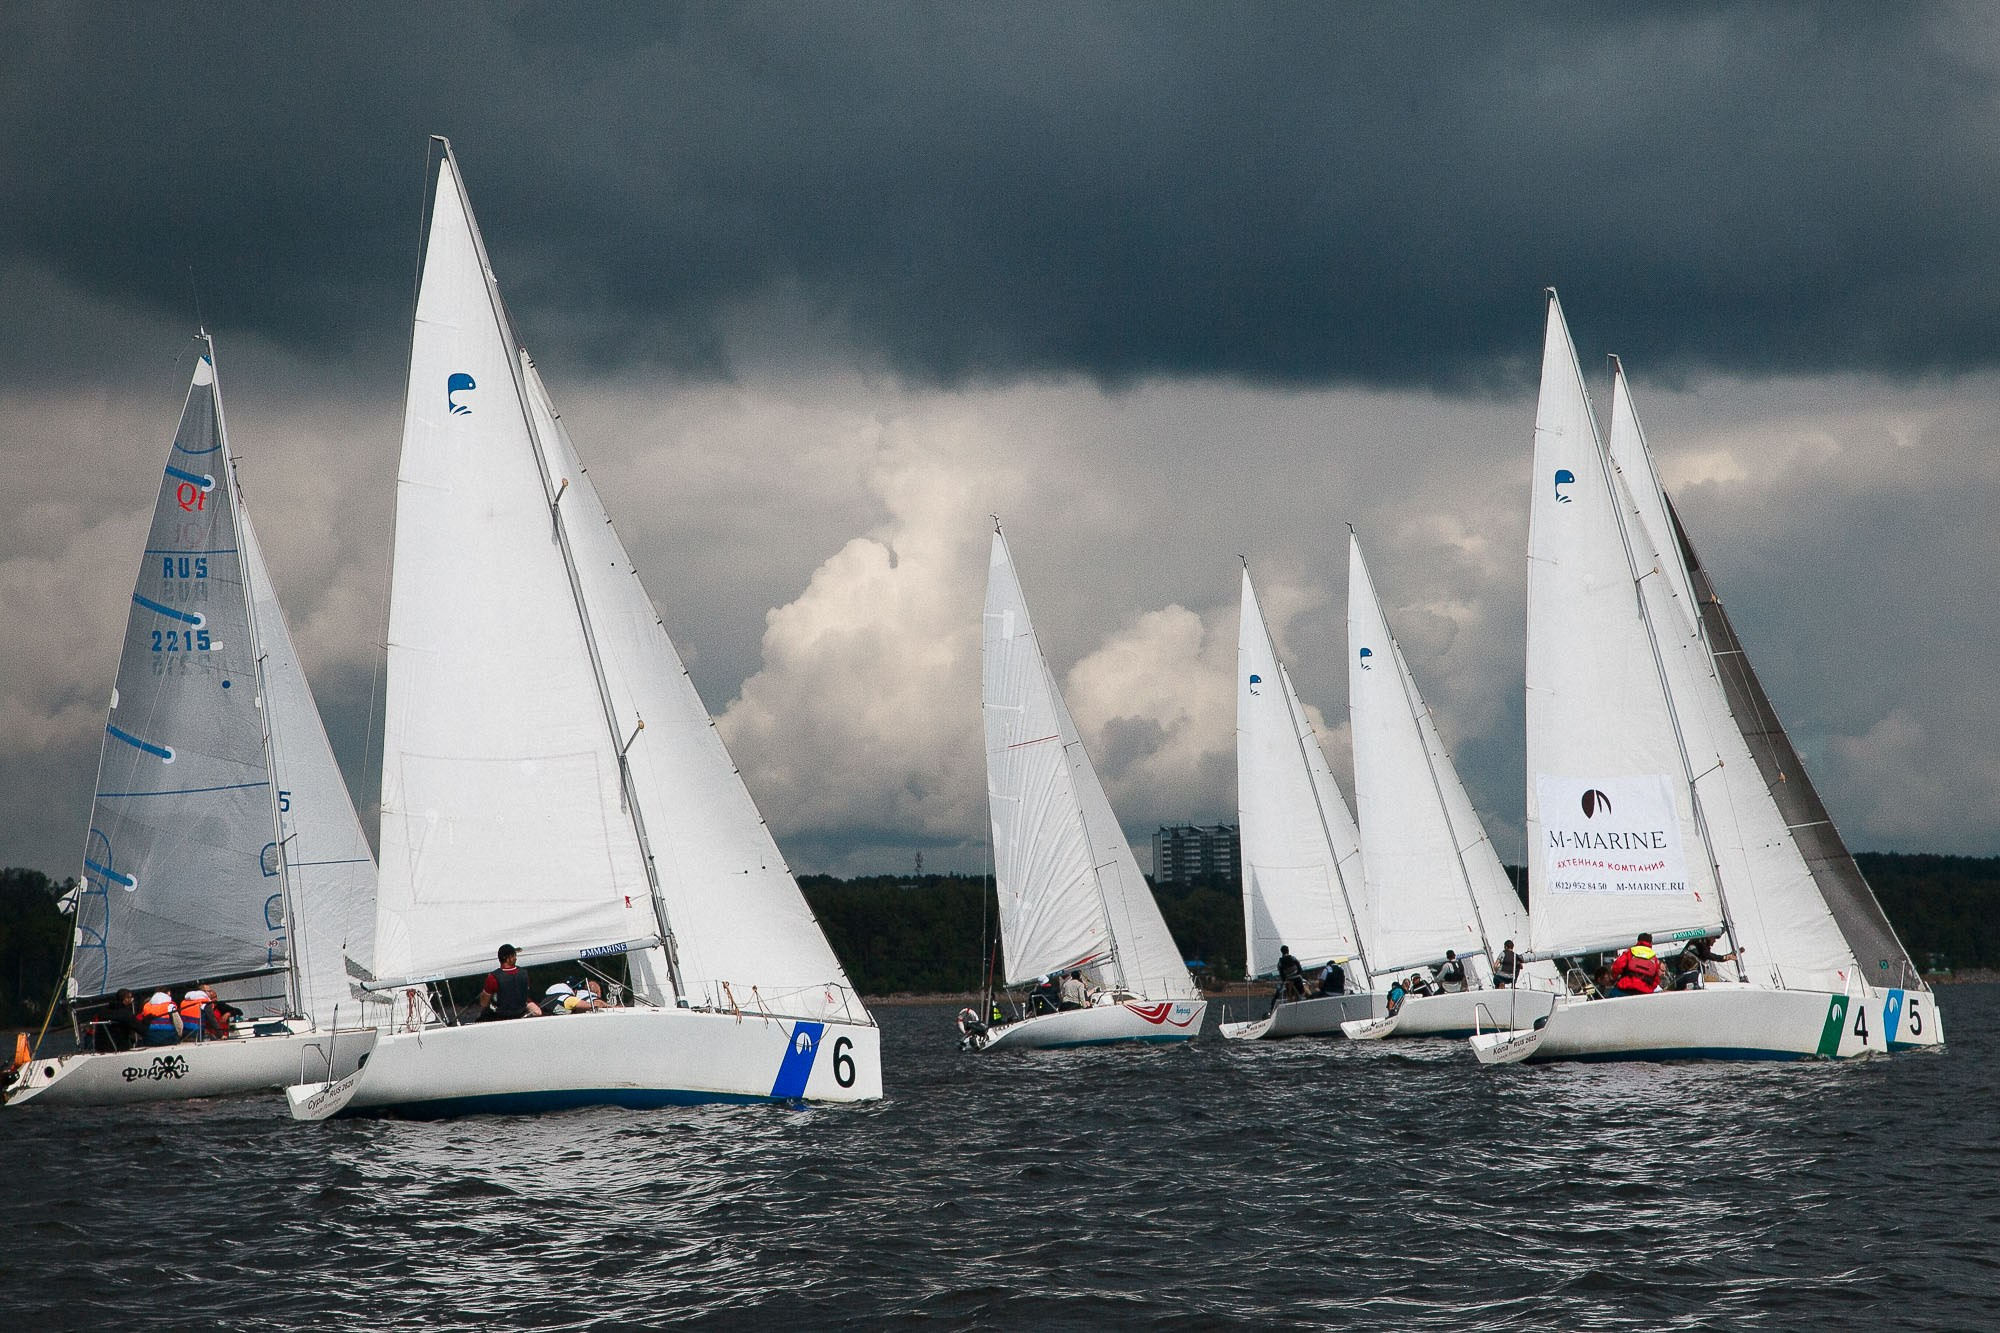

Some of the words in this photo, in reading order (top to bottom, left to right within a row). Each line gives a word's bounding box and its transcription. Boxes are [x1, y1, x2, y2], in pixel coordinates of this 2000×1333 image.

[177, 482, 207, 512] Qt
[163, 556, 208, 579] RUS
[151, 629, 211, 651] 2215
[1549, 830, 1667, 850] M-MARINE
[1607, 860, 1665, 873] КОМПАНИЯ
[1616, 881, 1685, 891] M-MARINE.RU
[580, 943, 627, 957] #MMARINE
[1853, 1005, 1869, 1046] 4
[1909, 998, 1922, 1036] 5
[1513, 1039, 1525, 1048] RUS
[833, 1036, 856, 1088] 6
[329, 1086, 341, 1098] RUS
